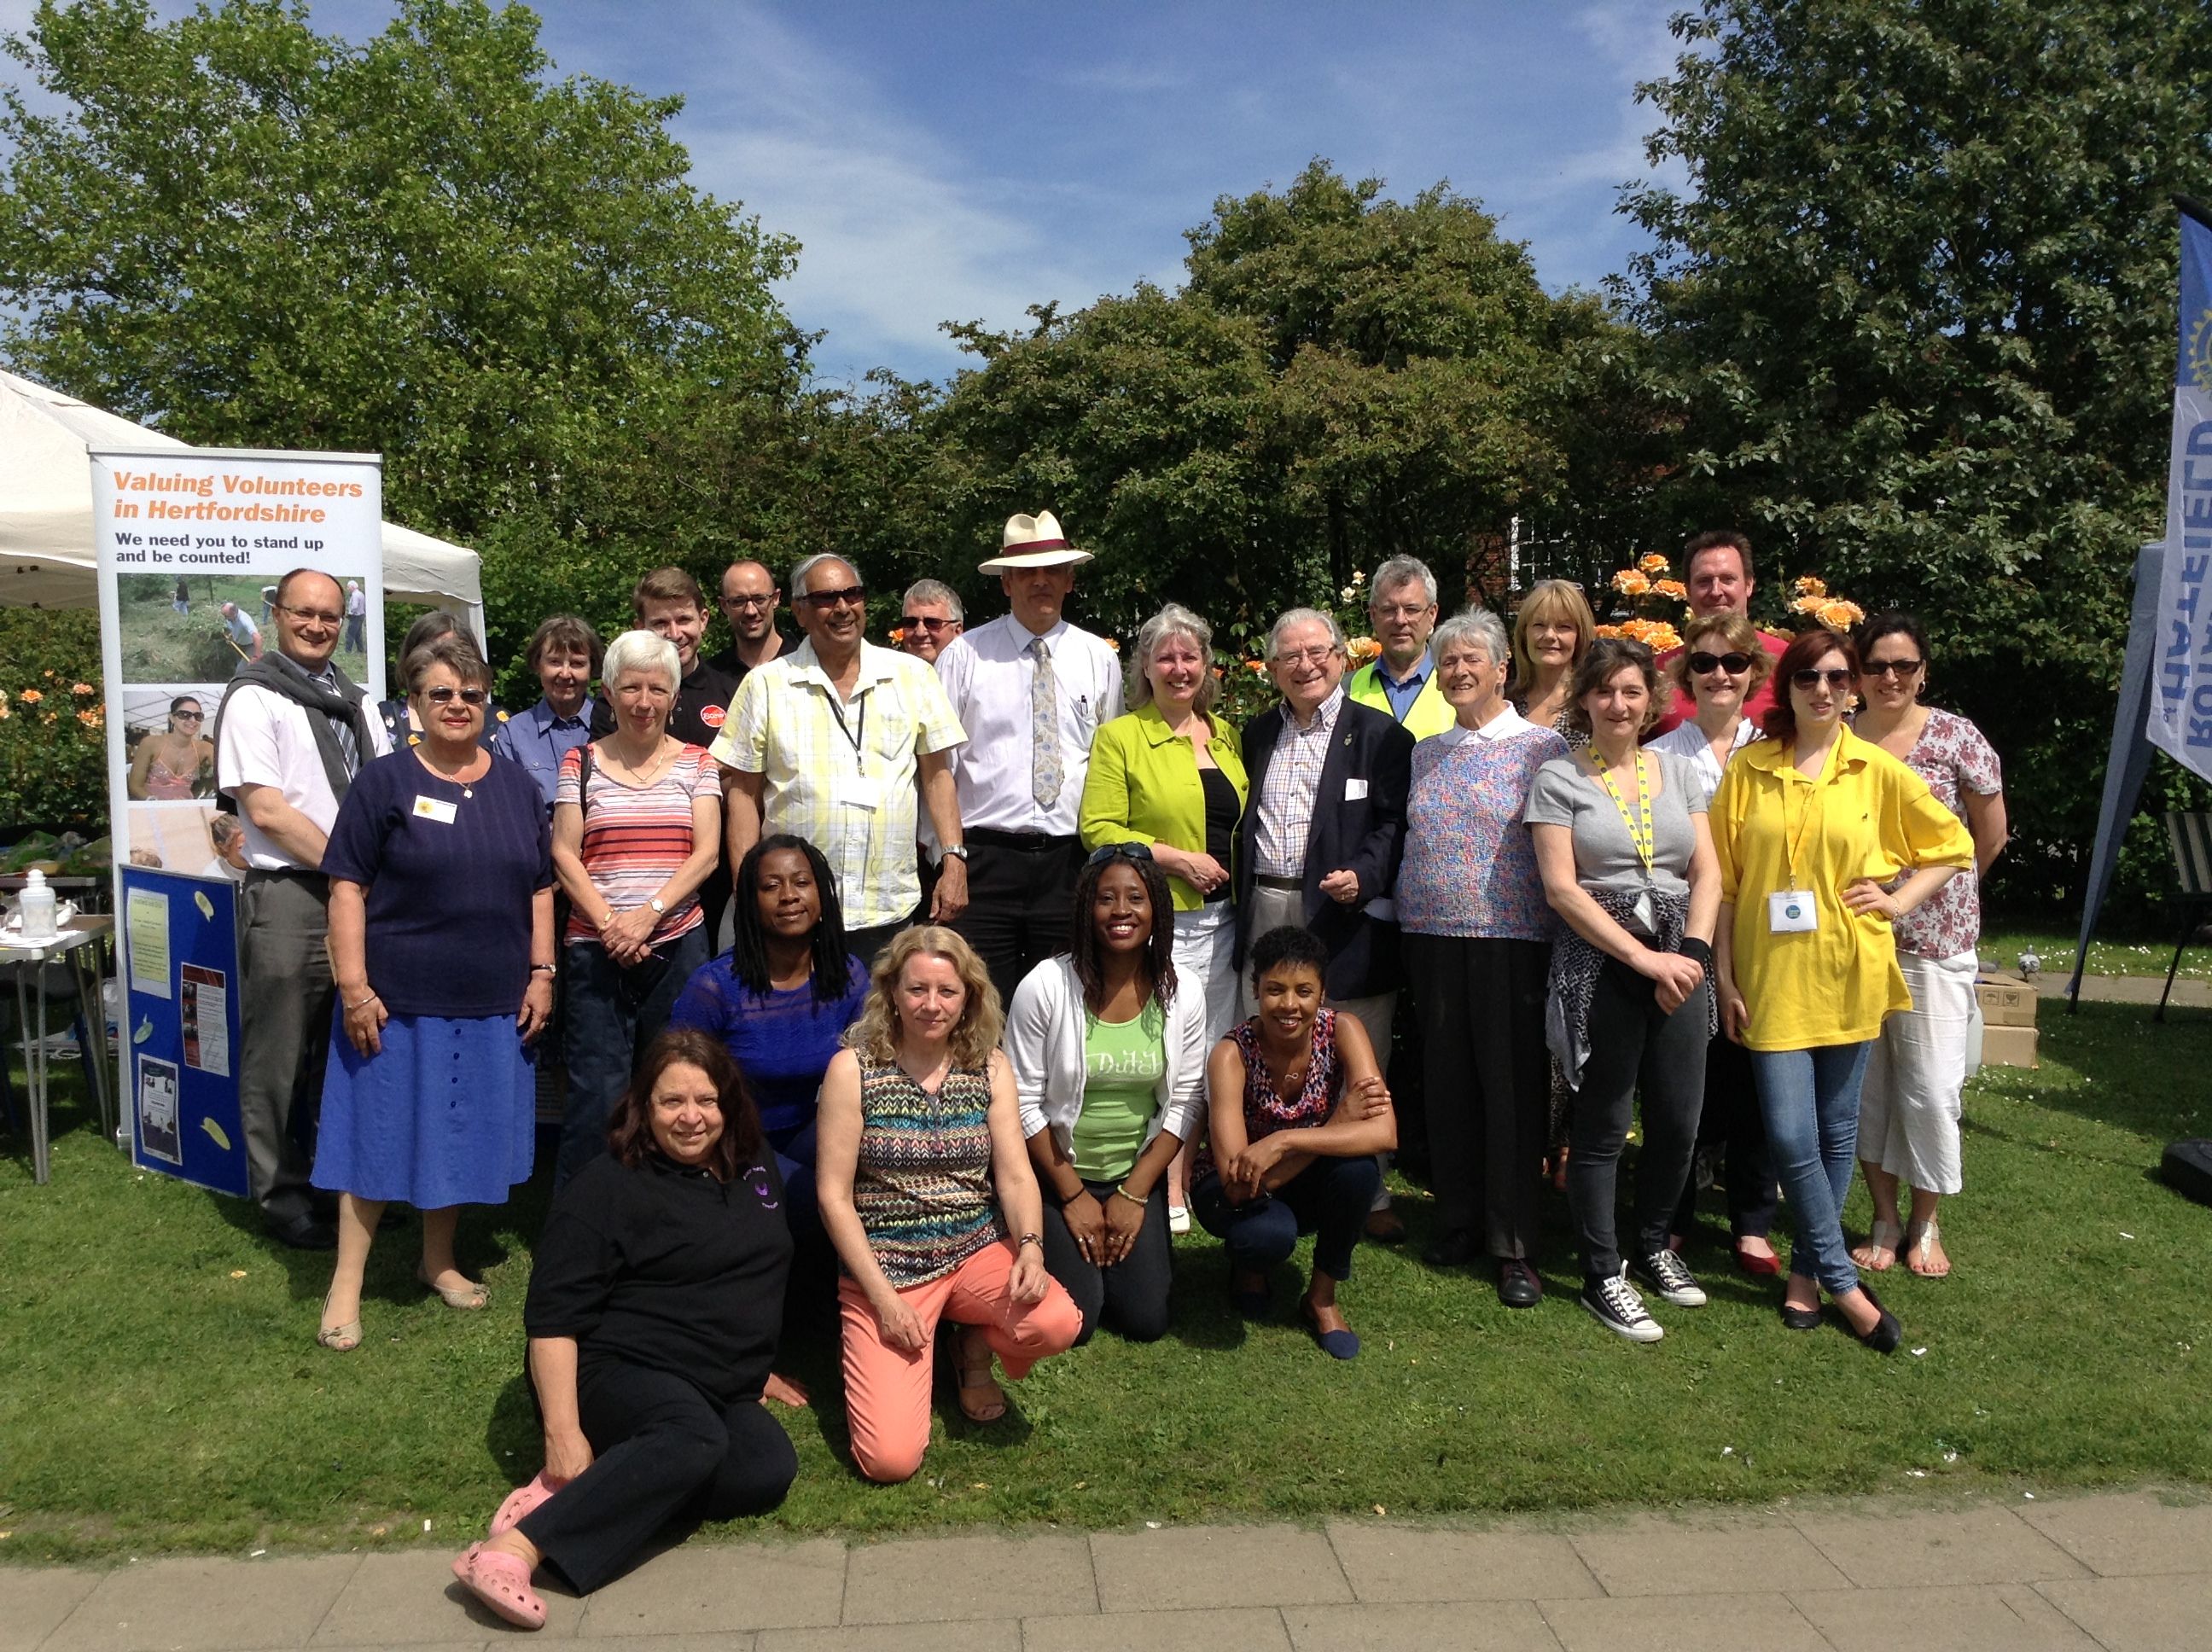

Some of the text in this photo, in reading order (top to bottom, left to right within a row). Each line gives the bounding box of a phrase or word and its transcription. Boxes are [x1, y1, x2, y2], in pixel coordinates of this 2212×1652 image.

[114, 471, 364, 497] Valuing Volunteers
[114, 499, 326, 523] in Hertfordshire
[115, 532, 324, 551] We need you to stand up
[116, 550, 251, 564] and be counted!
